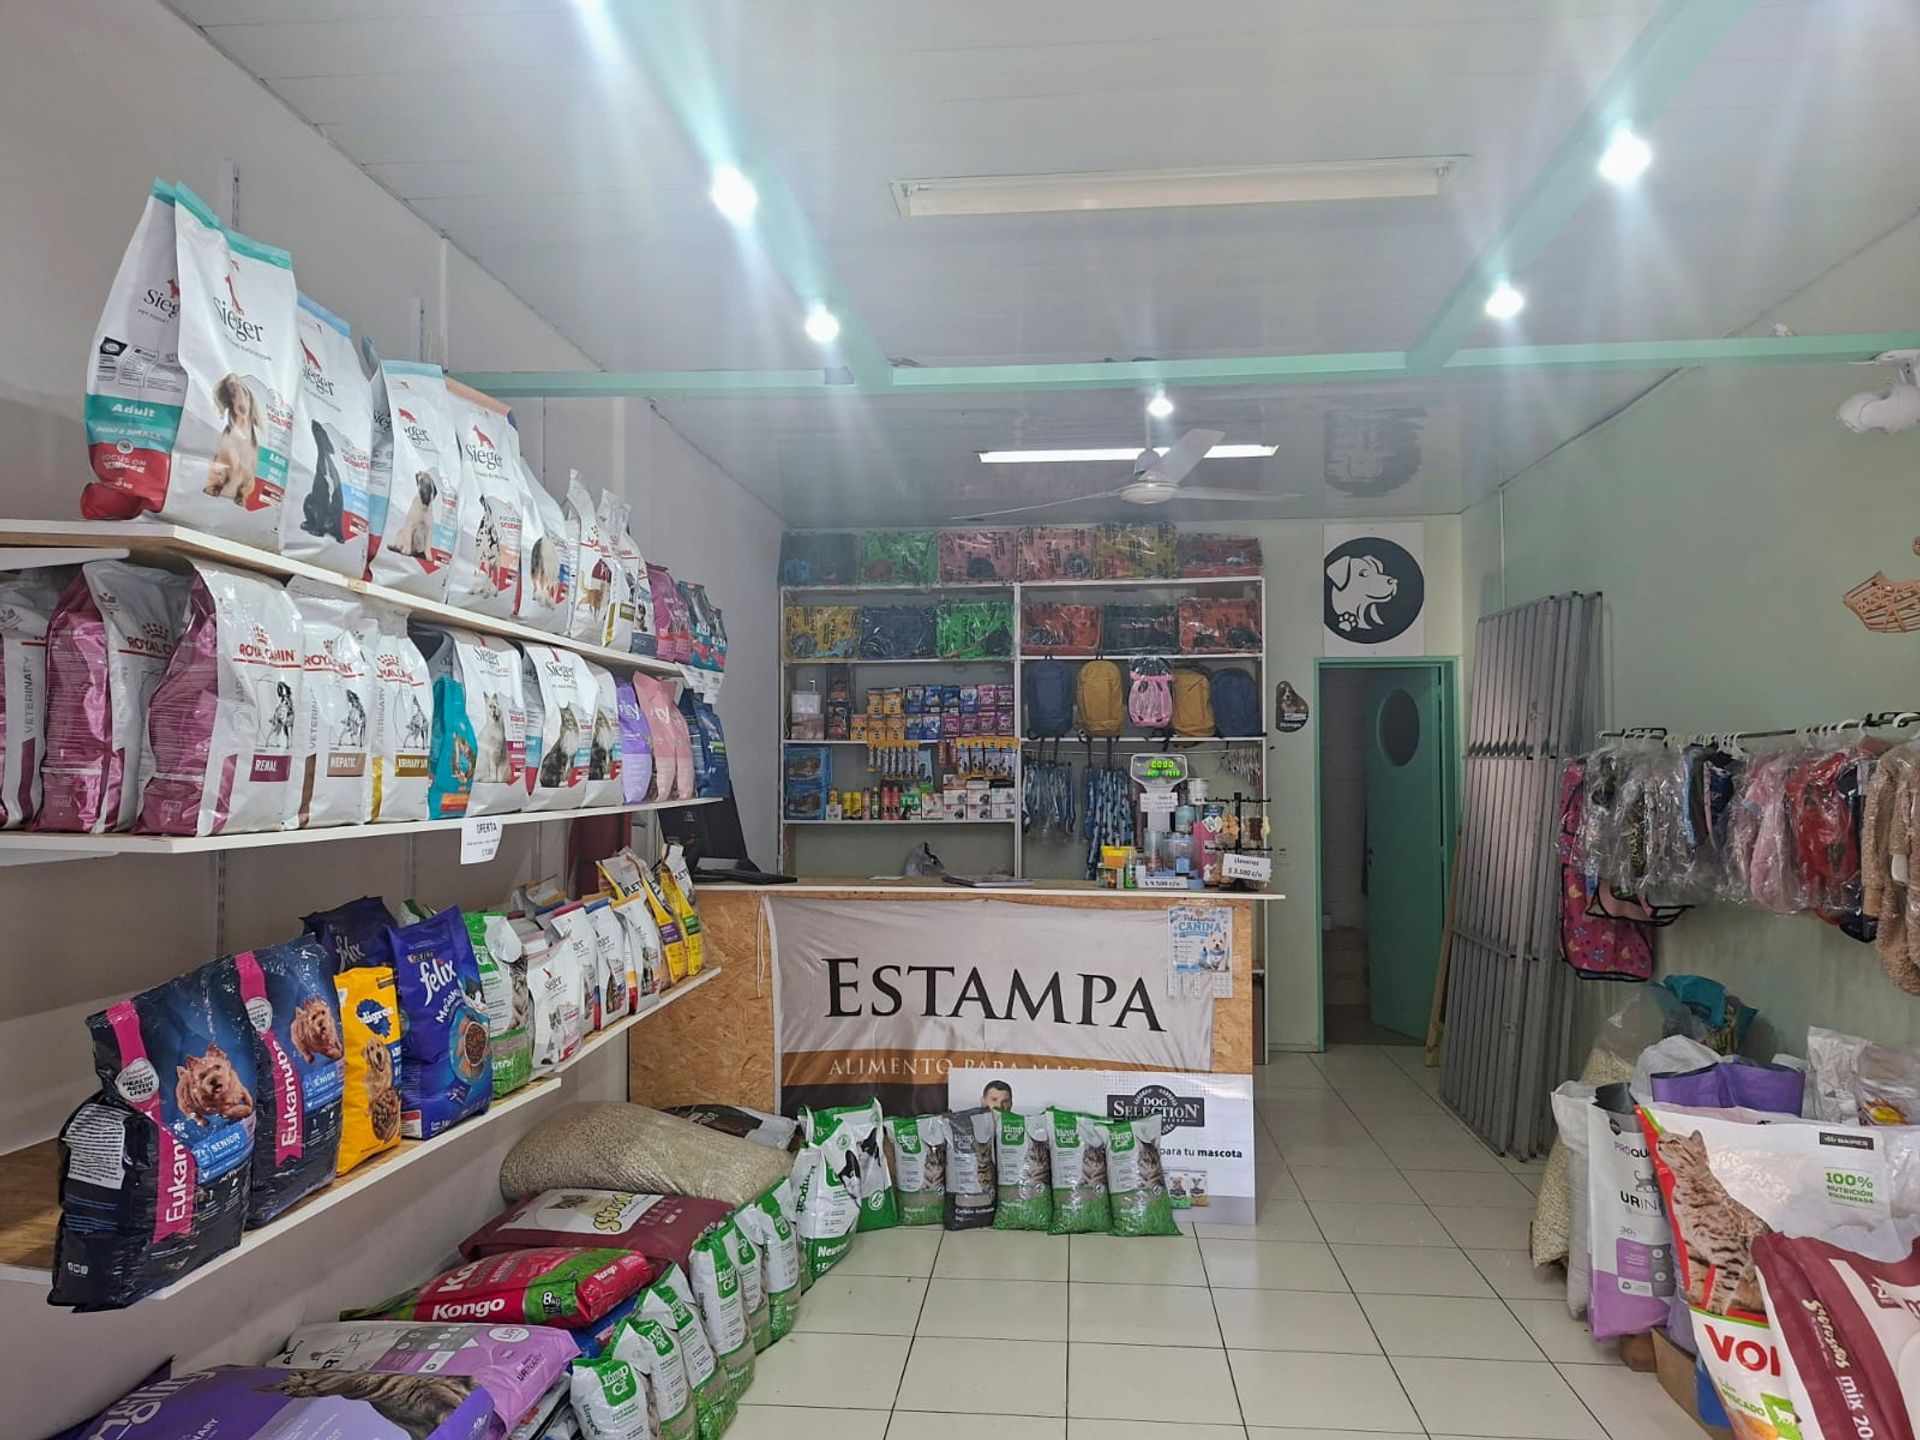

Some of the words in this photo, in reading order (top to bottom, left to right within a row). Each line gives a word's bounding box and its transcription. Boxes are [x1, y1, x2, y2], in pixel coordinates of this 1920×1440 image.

[111, 402, 156, 418] Adult
[23, 656, 33, 735] VETERINARY
[254, 760, 278, 772] RENAL
[1178, 922, 1222, 934] CANINA
[420, 958, 457, 1007] felix
[821, 957, 1167, 1033] ESTAMPA
[828, 1057, 953, 1077] ALIMENTO
[1113, 1100, 1199, 1119] SELECTION
[1143, 1096, 1168, 1106] DOG
[210, 1132, 240, 1152] SENIOR
[1184, 1148, 1195, 1157] tu
[1198, 1148, 1244, 1159] mascota
[165, 1139, 188, 1223] Eukan
[1825, 1172, 1874, 1189] 100%
[594, 1264, 618, 1282] Kongo
[431, 1297, 506, 1320] Kongo
[1837, 1375, 1865, 1411] mix
